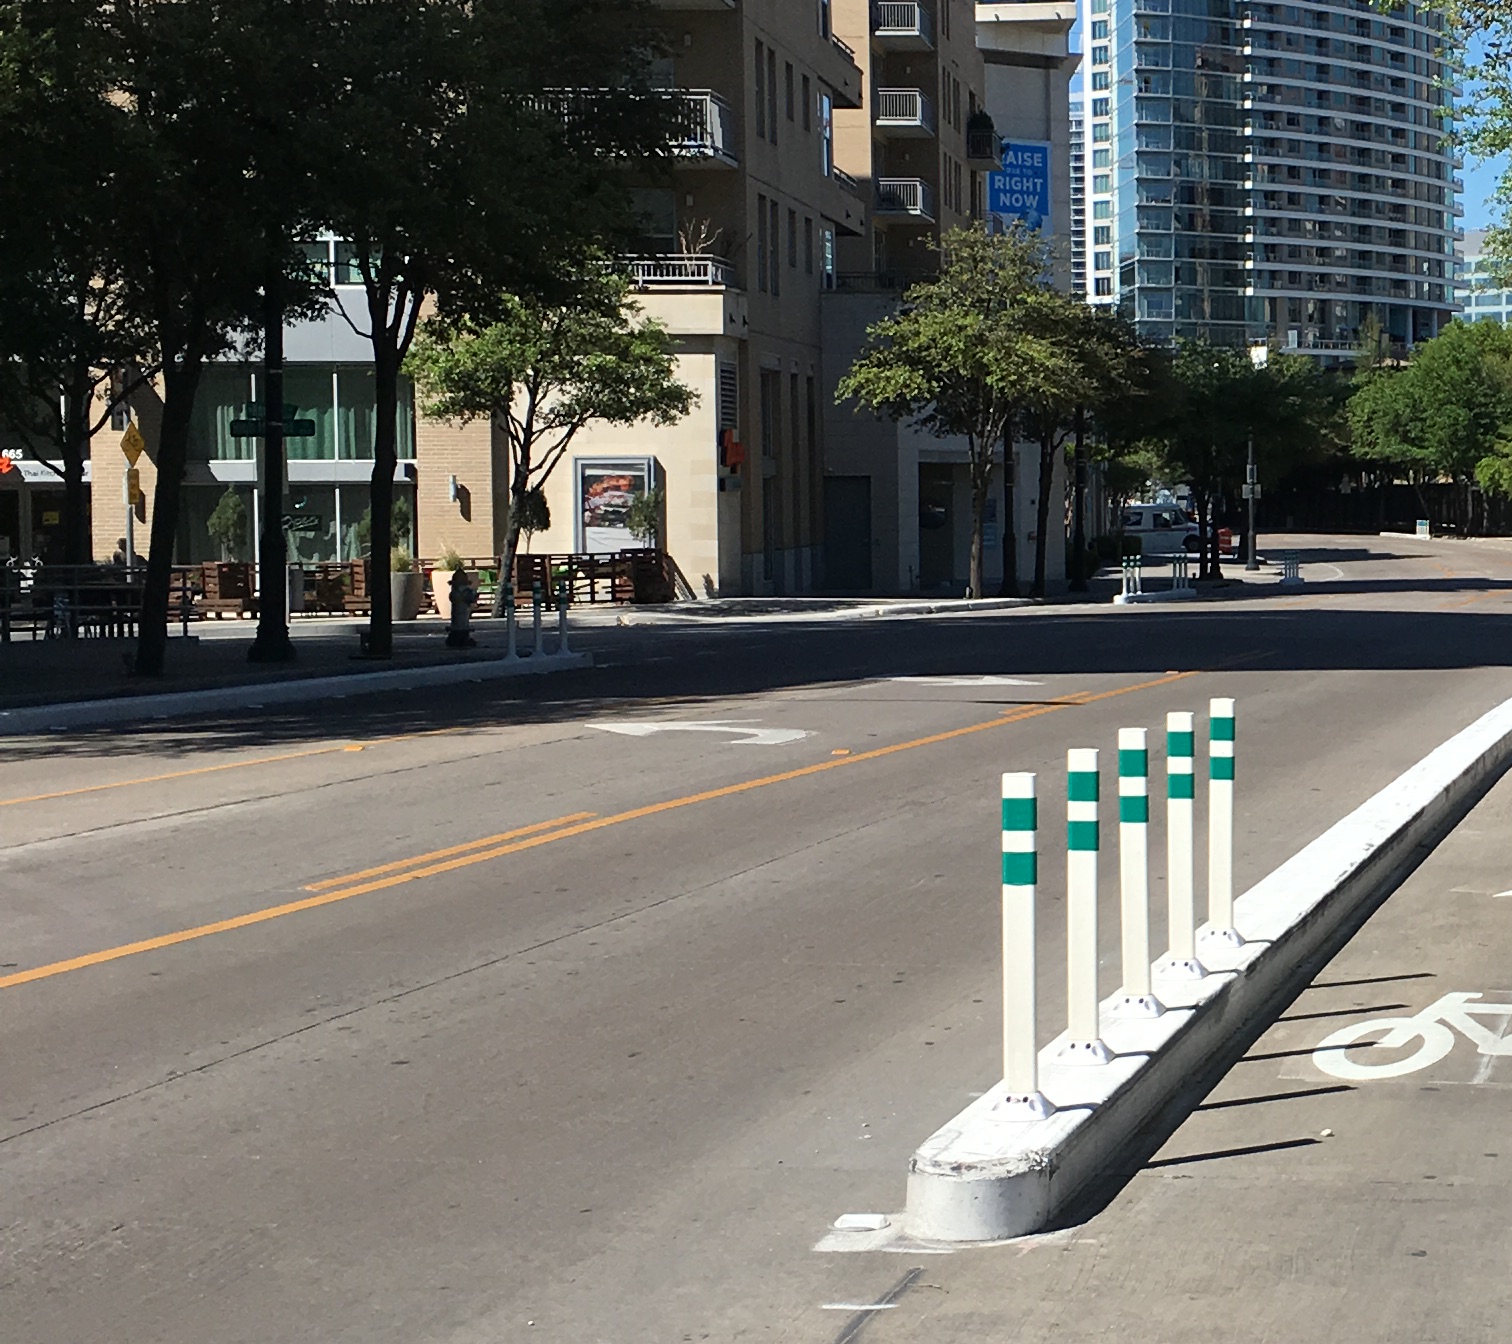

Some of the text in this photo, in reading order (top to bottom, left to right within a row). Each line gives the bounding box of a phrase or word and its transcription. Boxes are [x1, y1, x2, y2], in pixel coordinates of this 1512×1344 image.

[994, 175, 1043, 193] RIGHT
[999, 192, 1039, 209] NOW
[1, 448, 23, 459] 665
